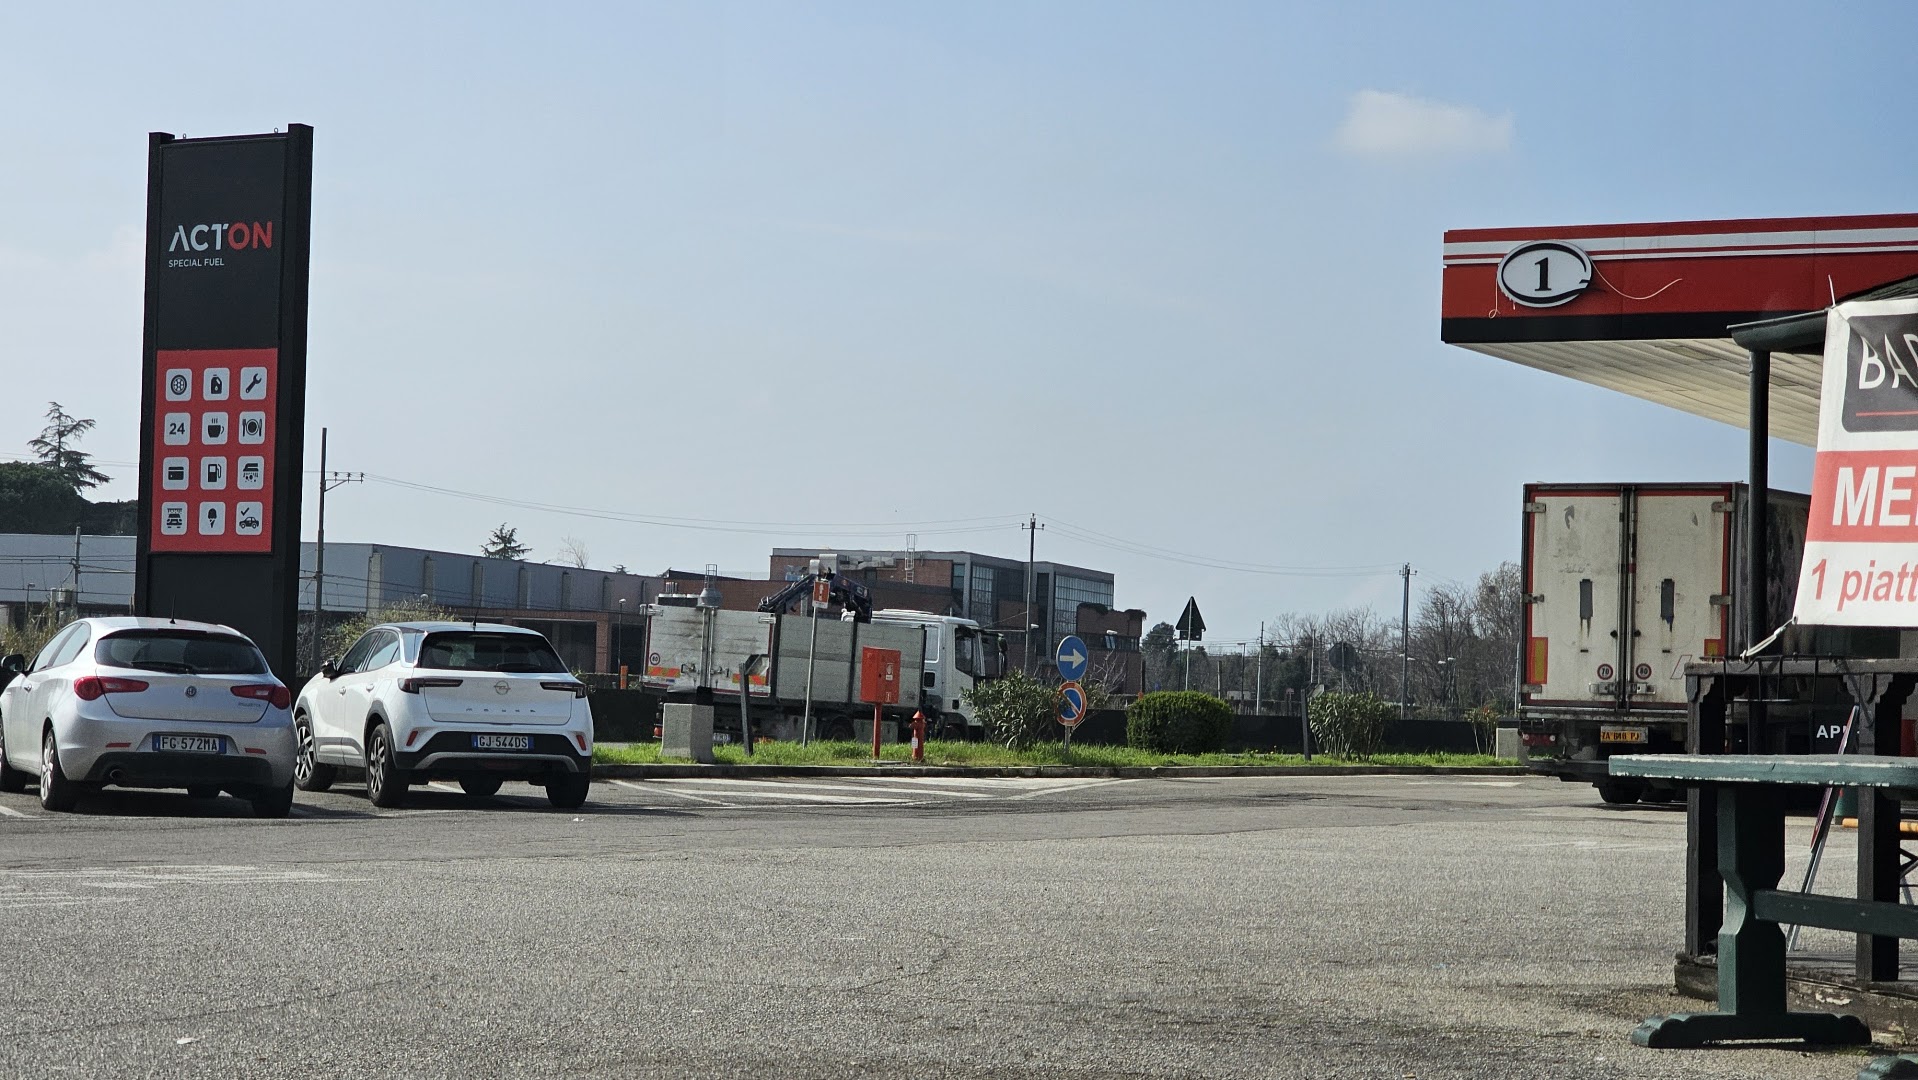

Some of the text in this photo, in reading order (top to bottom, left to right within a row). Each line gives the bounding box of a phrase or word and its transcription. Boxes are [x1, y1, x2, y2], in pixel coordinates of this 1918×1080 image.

[168, 220, 273, 252] ACTON
[168, 257, 225, 268] SPECIAL FUEL
[1535, 257, 1552, 292] 1
[169, 422, 186, 435] 24
[1832, 466, 1918, 527] ME
[1811, 558, 1918, 612] 1 piatt
[161, 736, 177, 749] FG
